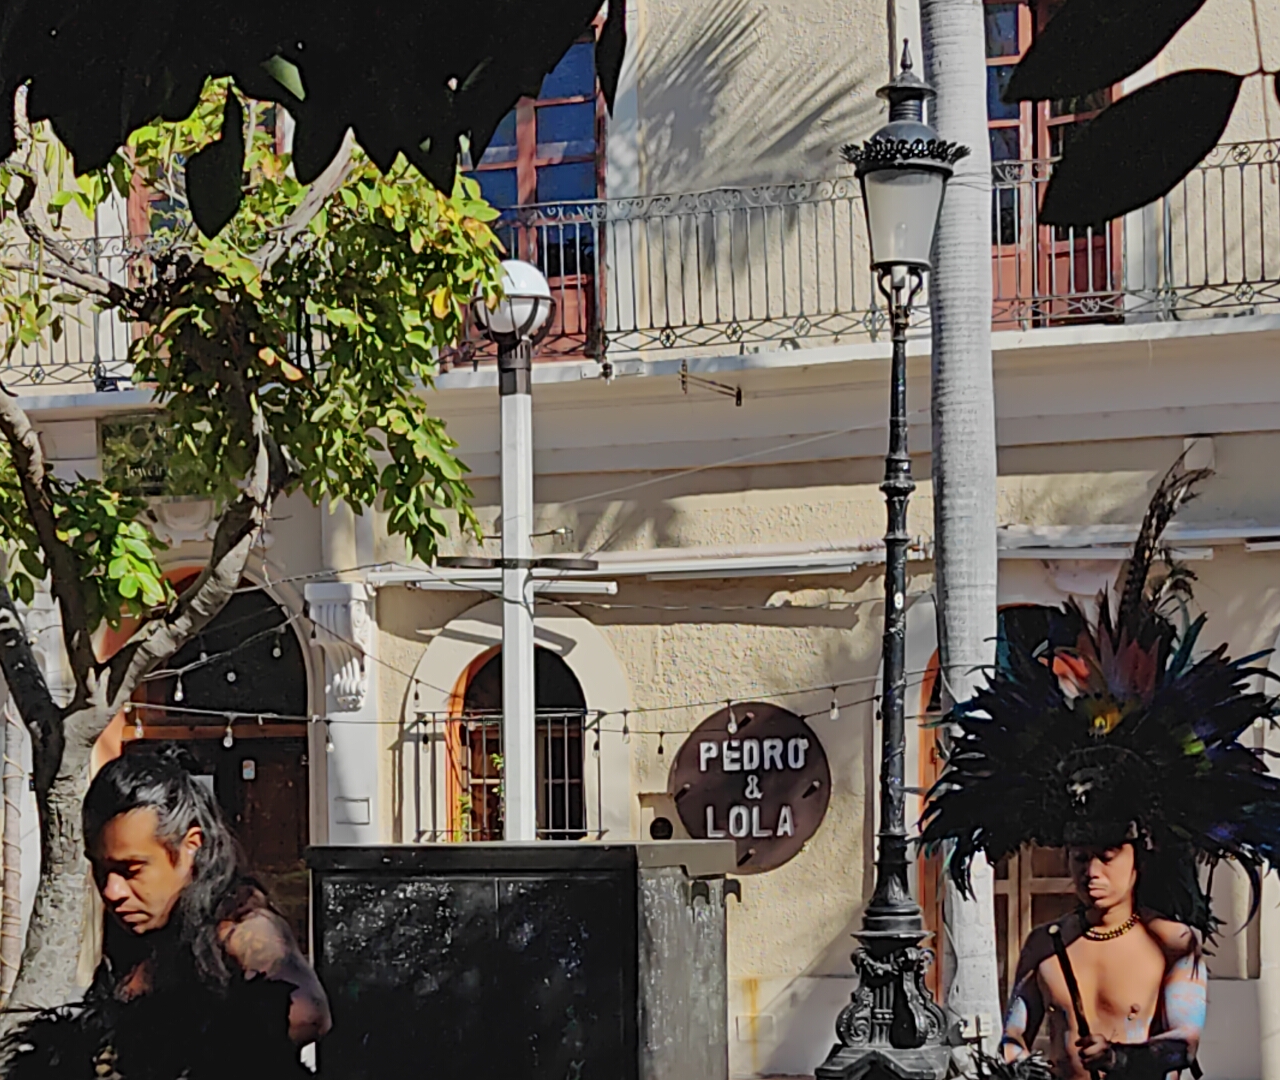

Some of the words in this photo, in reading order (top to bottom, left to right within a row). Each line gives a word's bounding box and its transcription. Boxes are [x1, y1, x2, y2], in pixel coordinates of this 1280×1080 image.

[699, 737, 807, 772] PEDRO
[744, 774, 764, 800] &
[705, 804, 796, 839] LOLA
